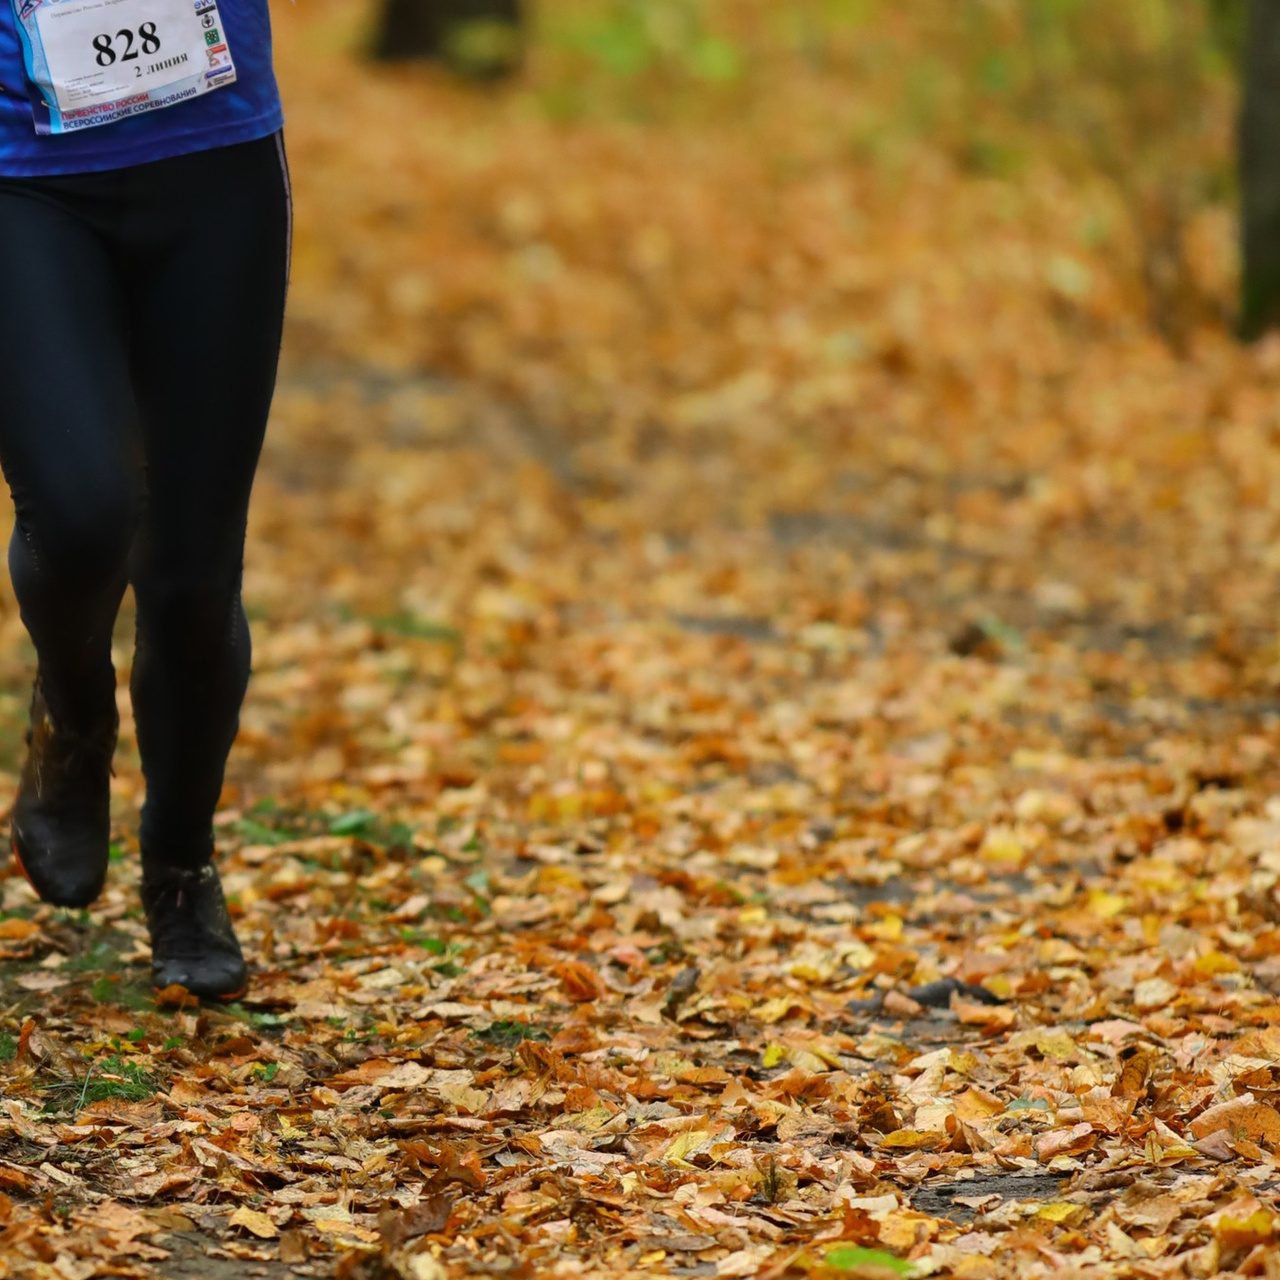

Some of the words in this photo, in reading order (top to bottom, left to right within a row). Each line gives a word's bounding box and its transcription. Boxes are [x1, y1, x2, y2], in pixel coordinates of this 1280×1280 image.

[92, 21, 161, 67] 828
[134, 65, 142, 78] 2
[146, 52, 189, 75] линия
[61, 103, 115, 120] ПЕРВЕНСТВО
[115, 93, 150, 109] РОССИИ
[133, 87, 197, 113] СОРЕВНОВАНИЯ
